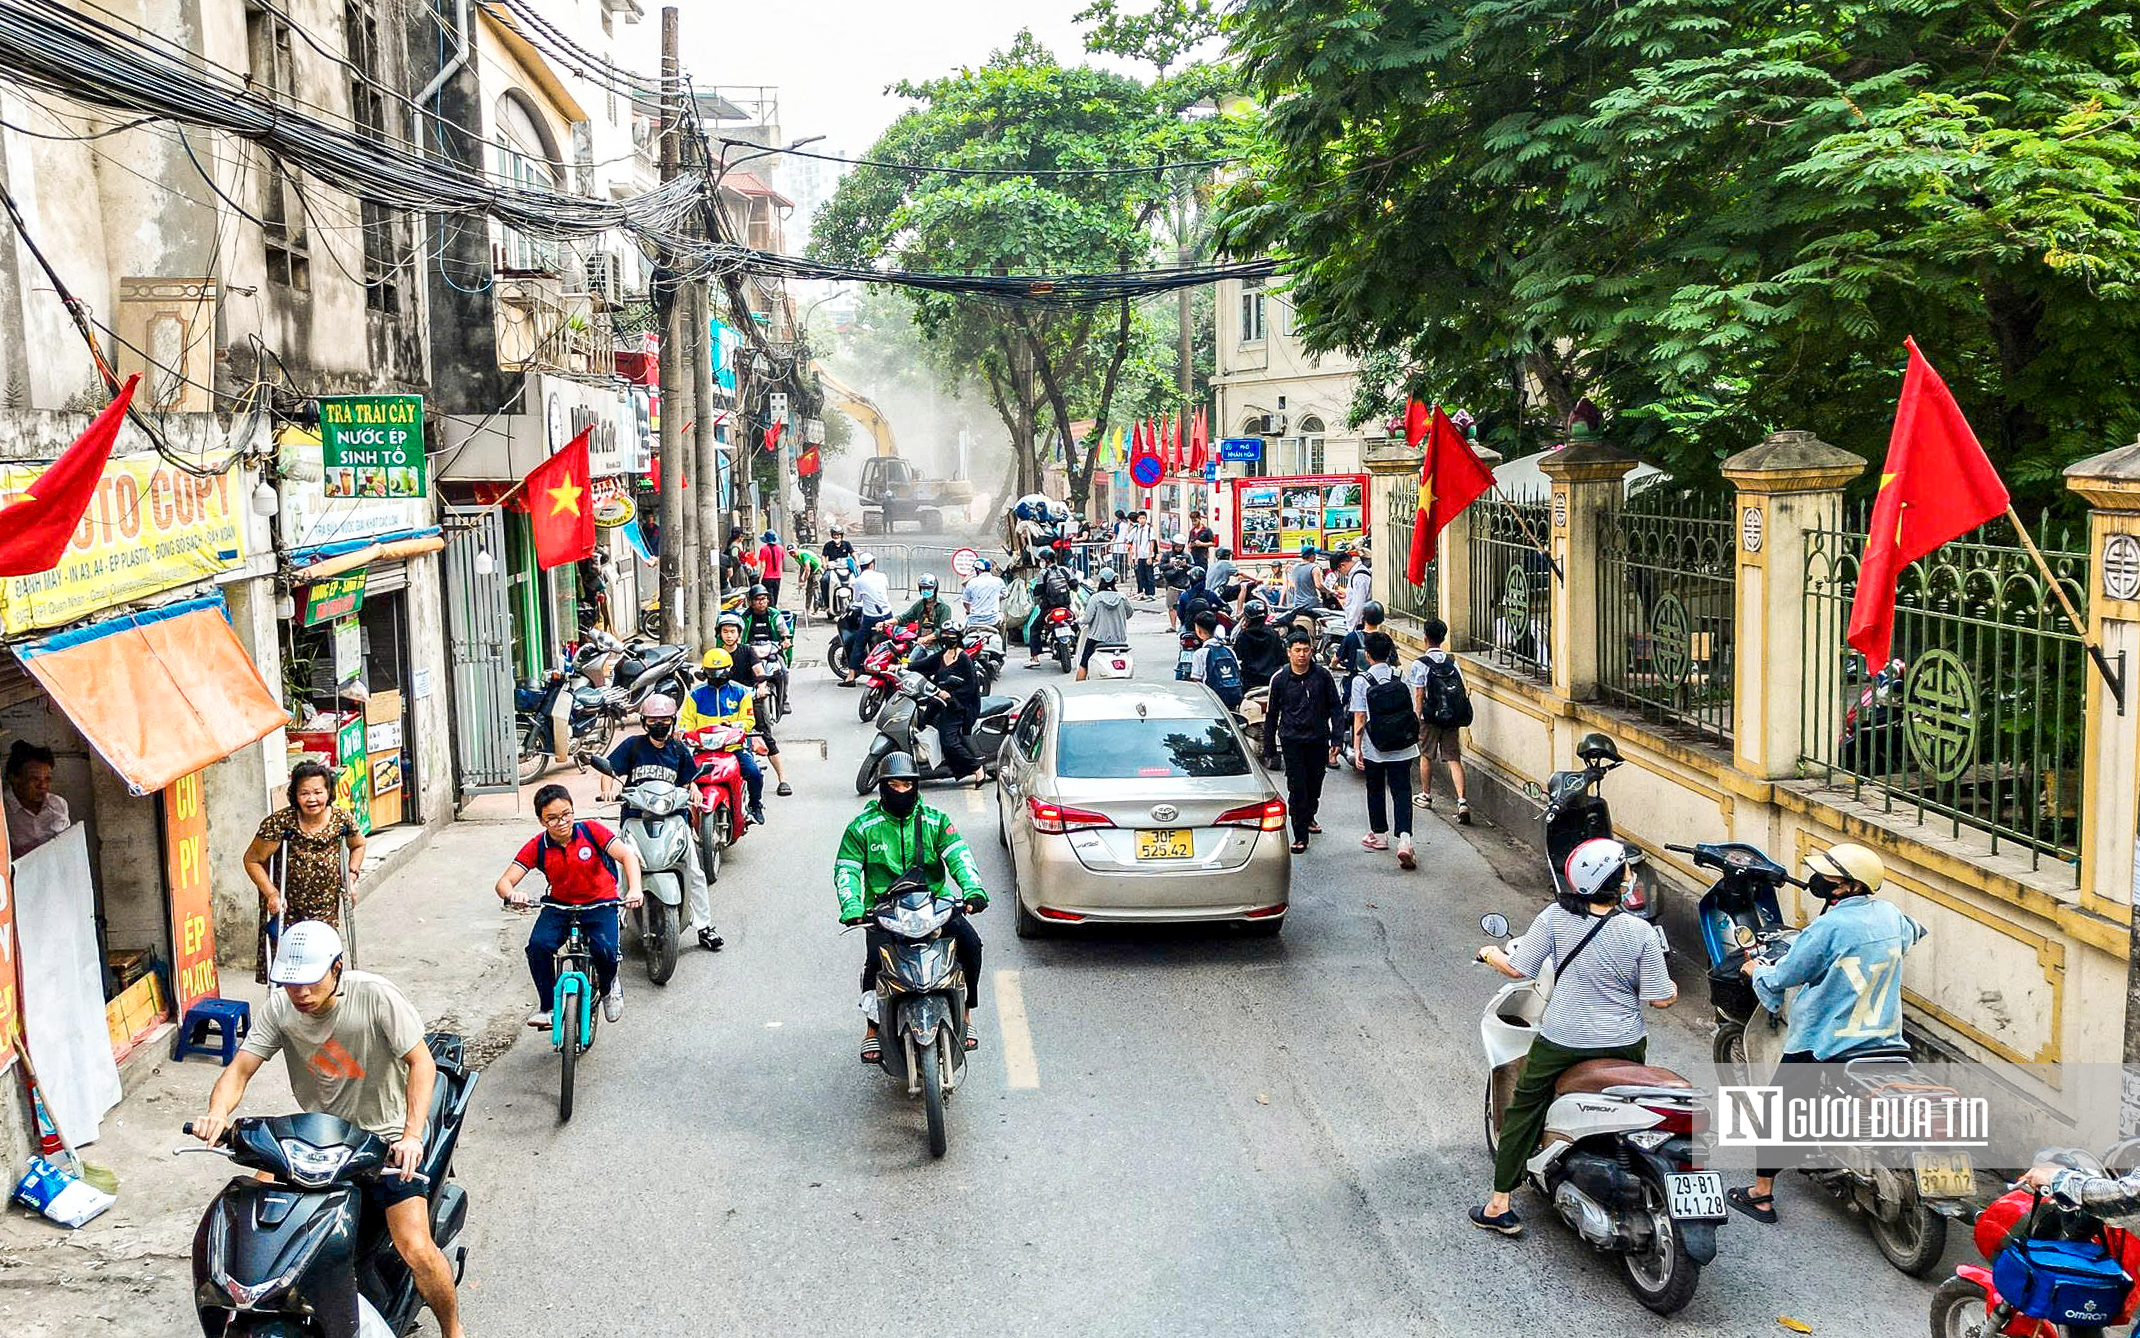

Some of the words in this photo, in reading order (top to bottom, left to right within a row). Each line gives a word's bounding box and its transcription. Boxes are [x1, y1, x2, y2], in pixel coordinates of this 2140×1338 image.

[326, 401, 351, 423] TRÀ
[355, 400, 386, 423] TRÁI
[389, 399, 415, 423] CÂY
[337, 428, 384, 445] NƯỚC
[389, 428, 407, 444] ÉP
[340, 451, 377, 464] SINH
[382, 446, 406, 464] TỐ
[150, 462, 229, 531] COPY
[1151, 831, 1175, 843] 30F
[871, 841, 888, 852] Grab
[1142, 844, 1187, 857] 525.42
[179, 835, 199, 889] PY
[184, 912, 205, 956] ÉP
[1675, 1177, 1716, 1195] 29-B1
[1675, 1196, 1723, 1215] 441.28
